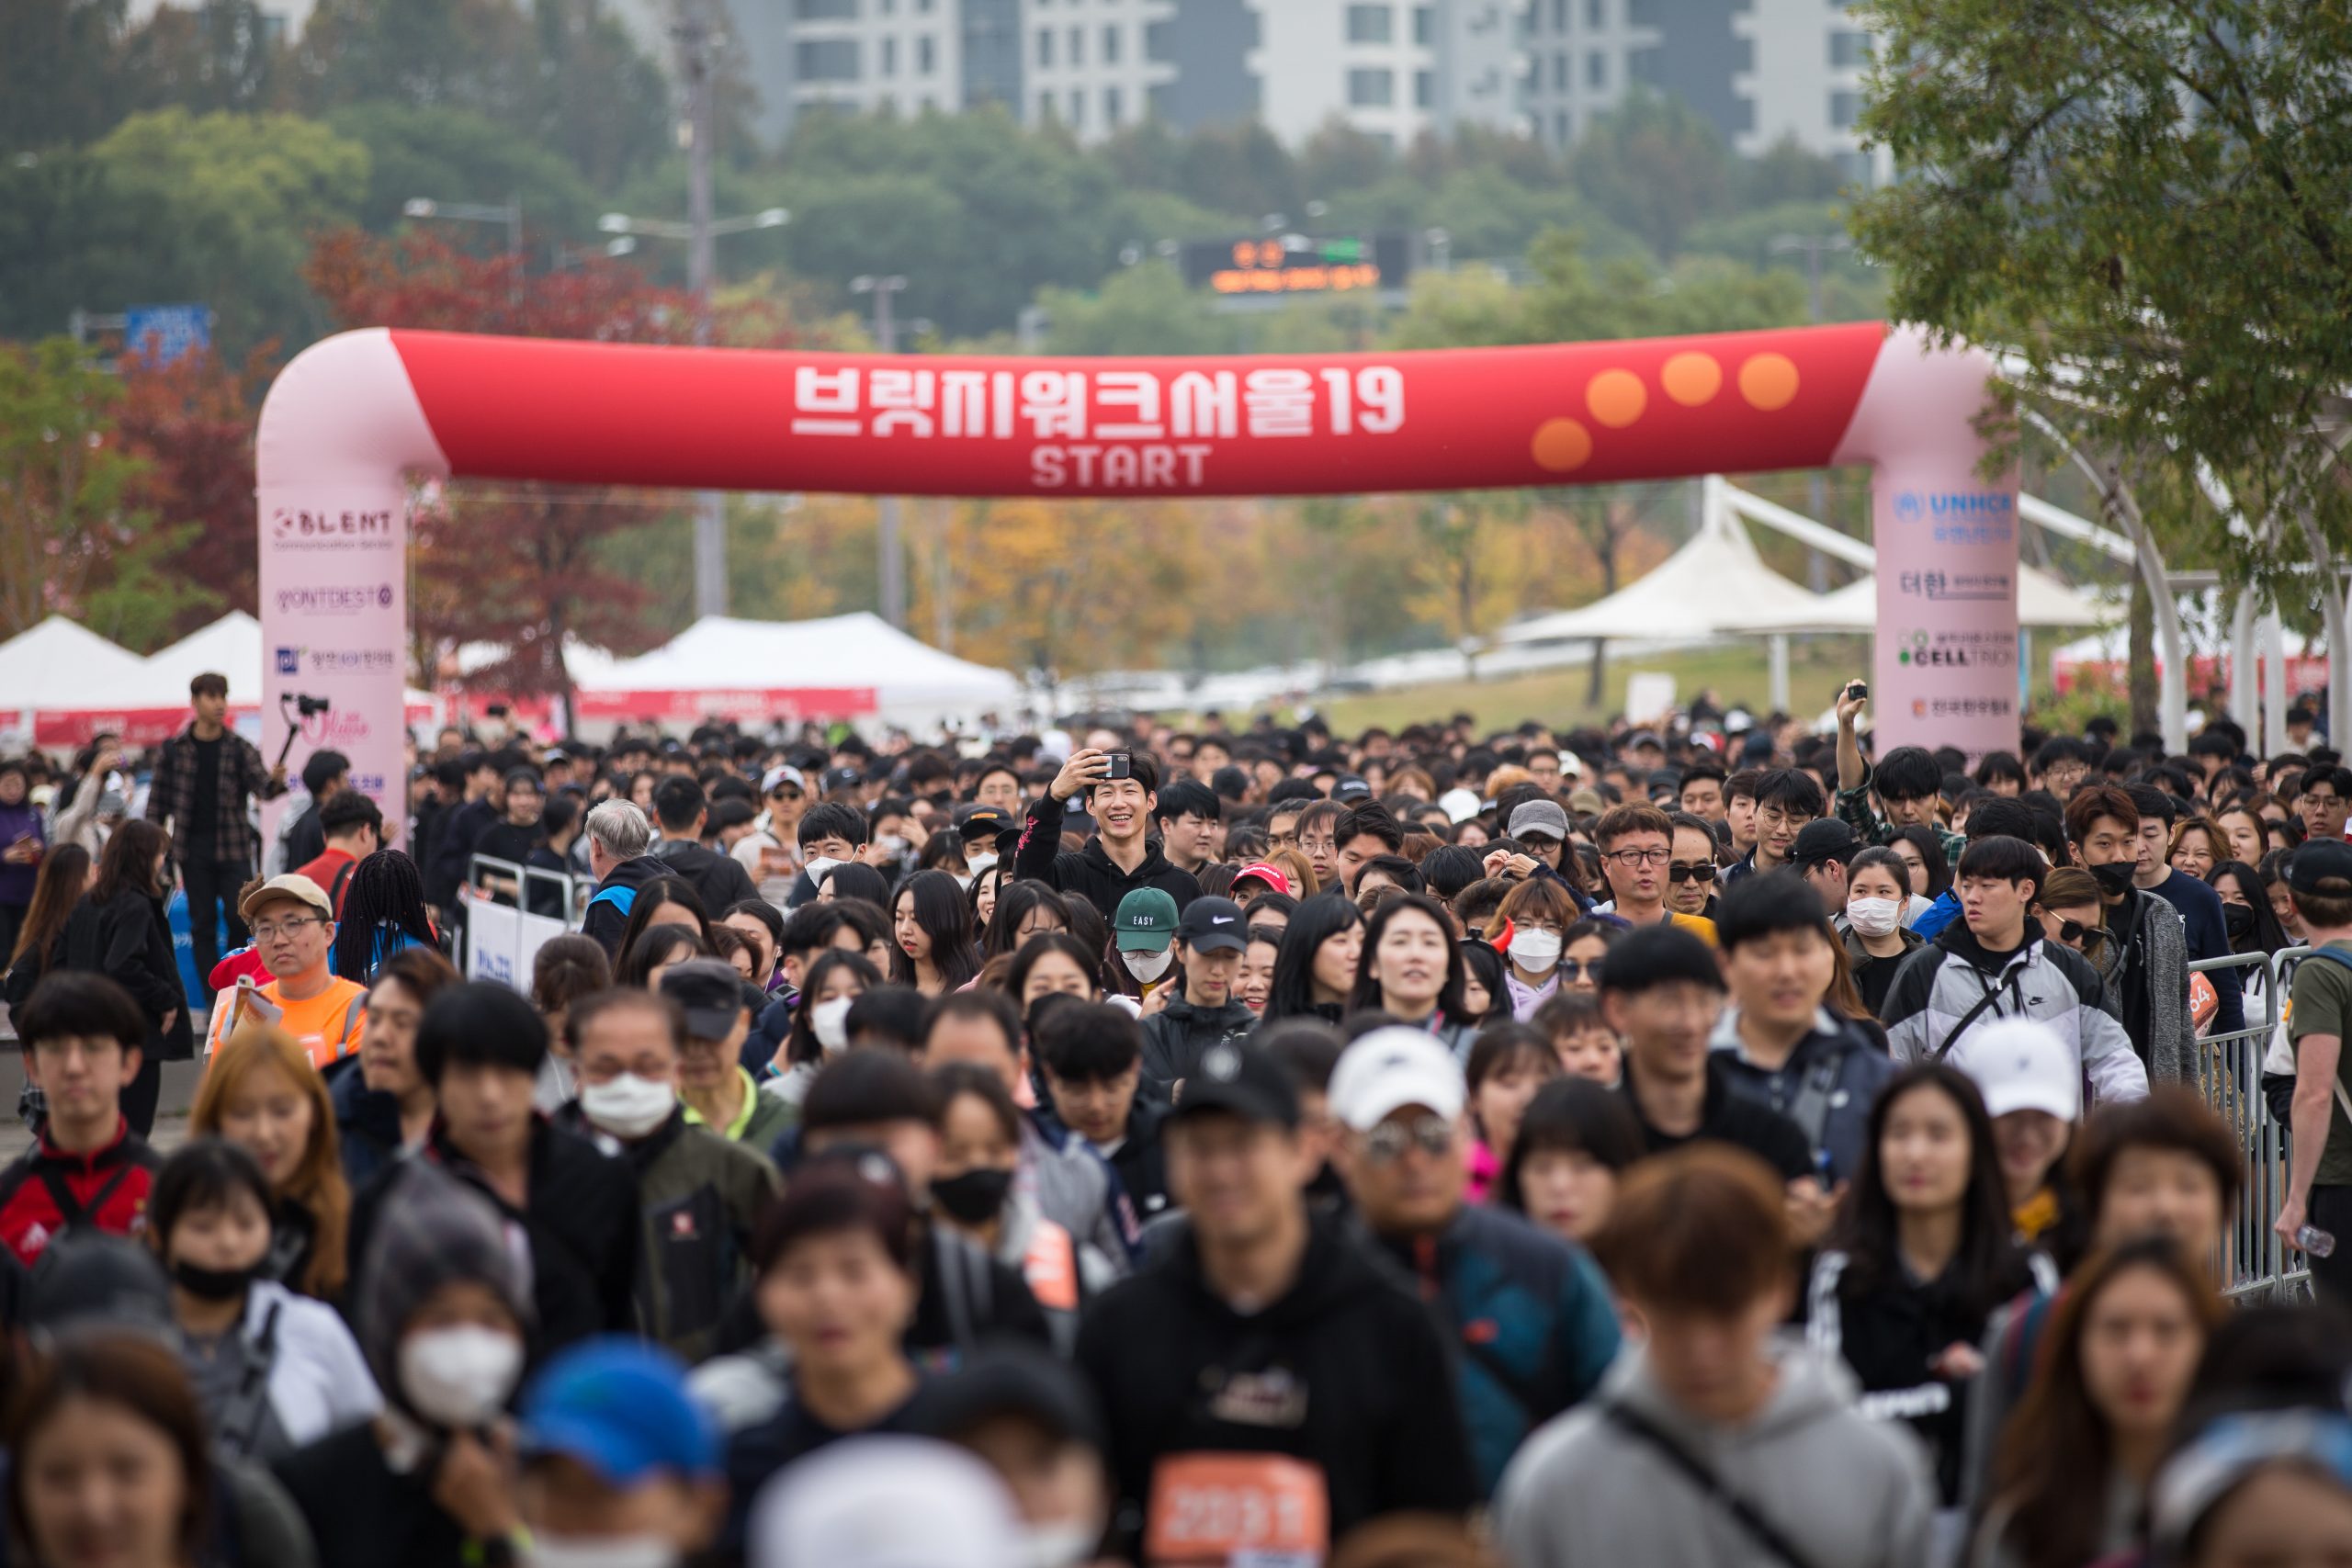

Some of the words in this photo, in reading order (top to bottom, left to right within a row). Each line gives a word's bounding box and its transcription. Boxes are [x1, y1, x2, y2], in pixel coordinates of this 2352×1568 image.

[791, 366, 1406, 439] 브릿지워크서울19
[1030, 445, 1213, 489] START
[1929, 493, 2012, 514] UNHCR
[299, 510, 392, 535] BLENT
[1133, 916, 1154, 926] EASY
